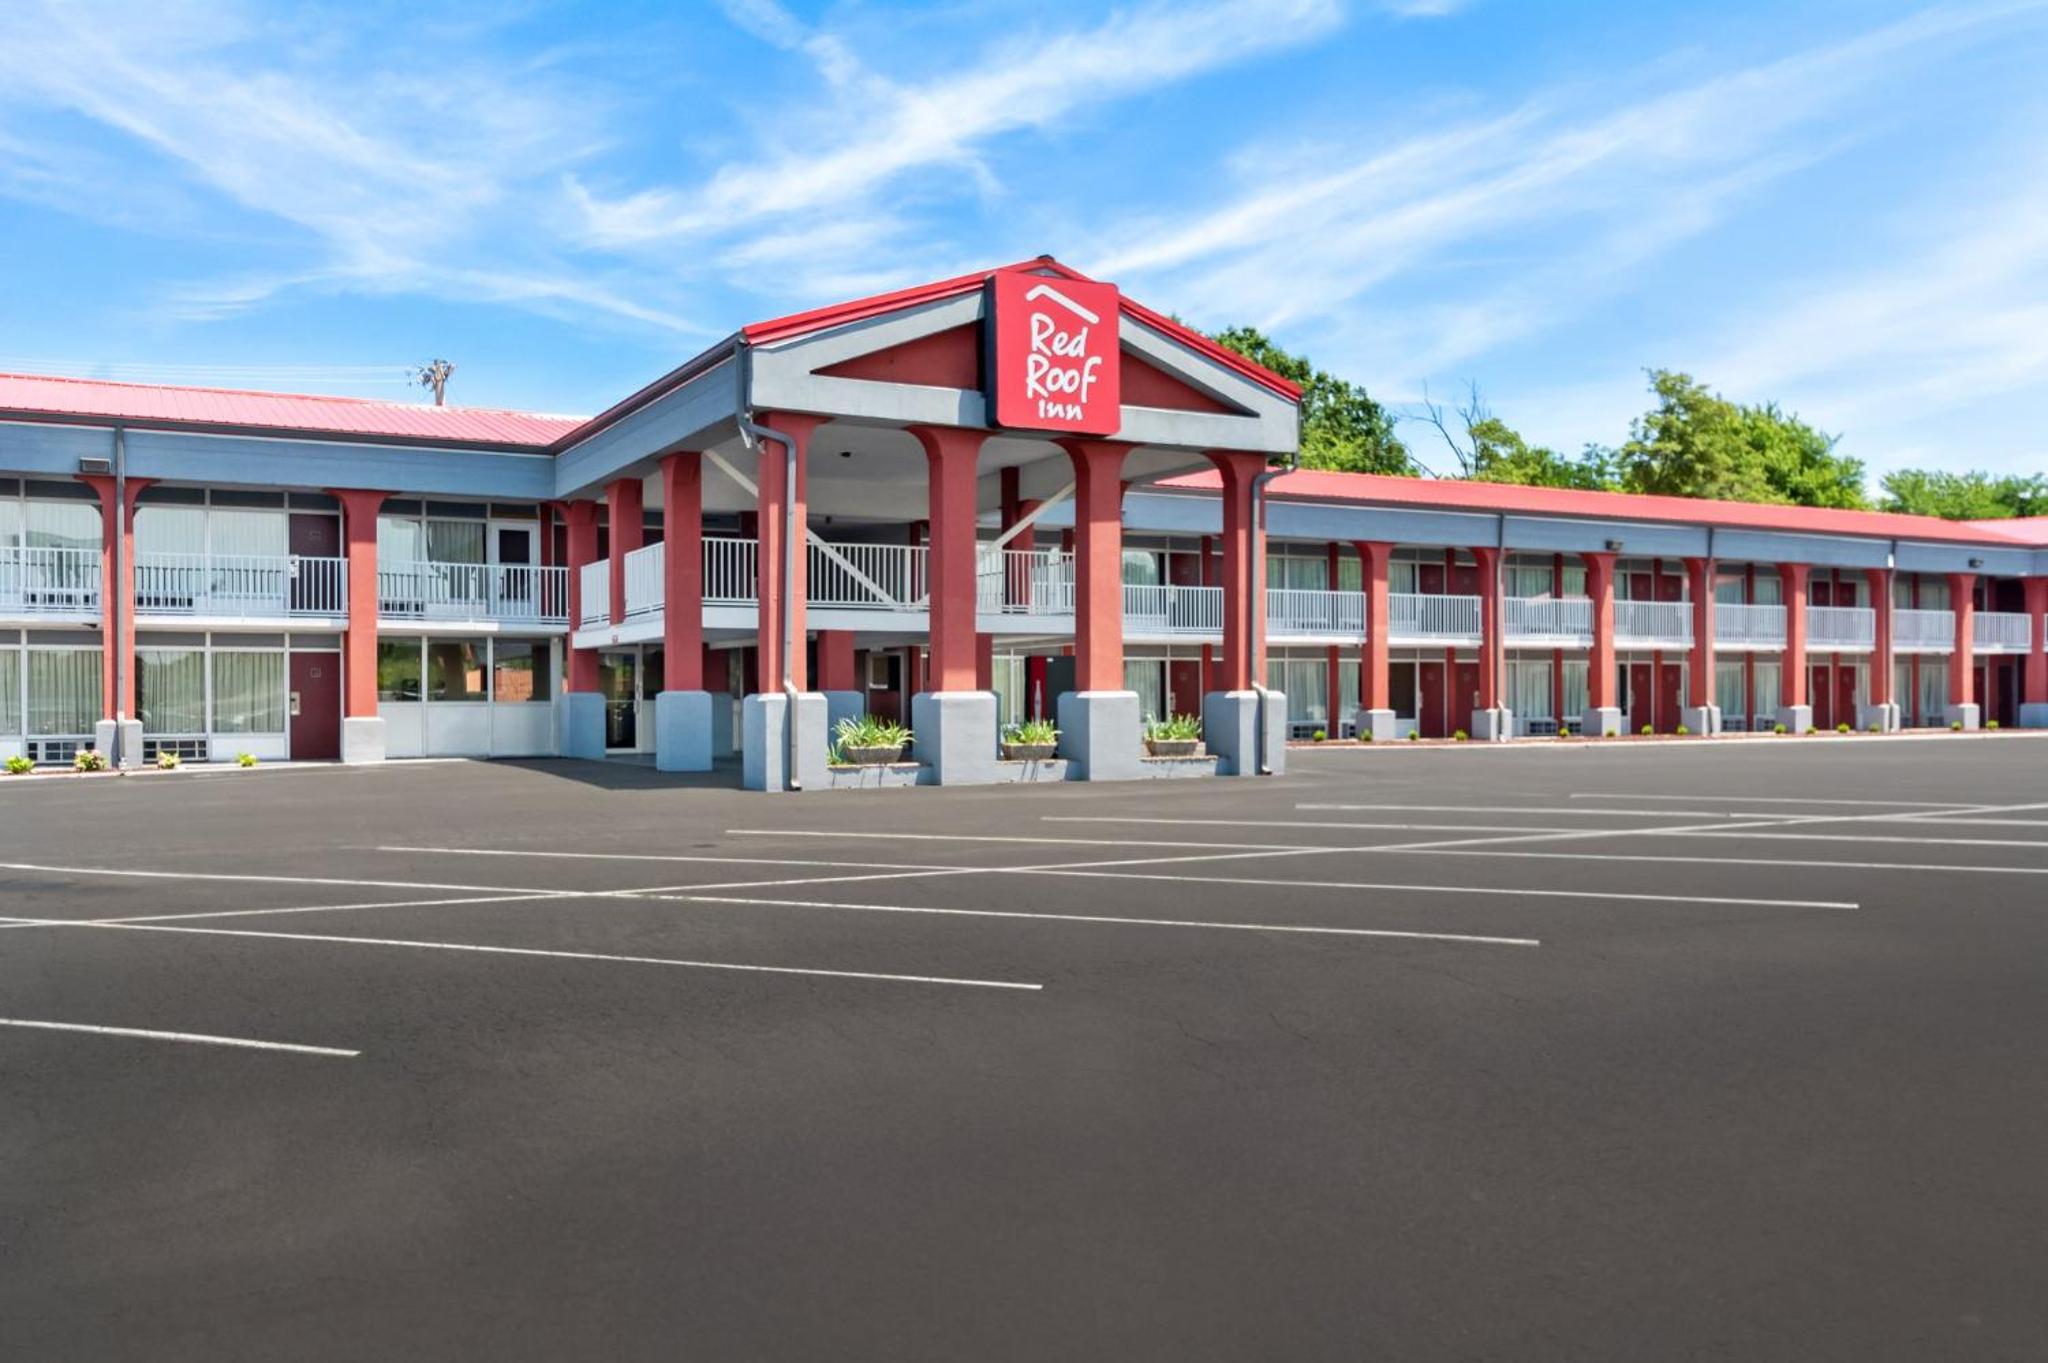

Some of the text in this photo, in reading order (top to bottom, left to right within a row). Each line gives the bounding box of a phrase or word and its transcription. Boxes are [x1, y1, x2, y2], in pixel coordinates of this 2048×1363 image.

[1031, 312, 1088, 356] Red
[1026, 353, 1102, 403] Roof
[1039, 399, 1083, 420] Inn
